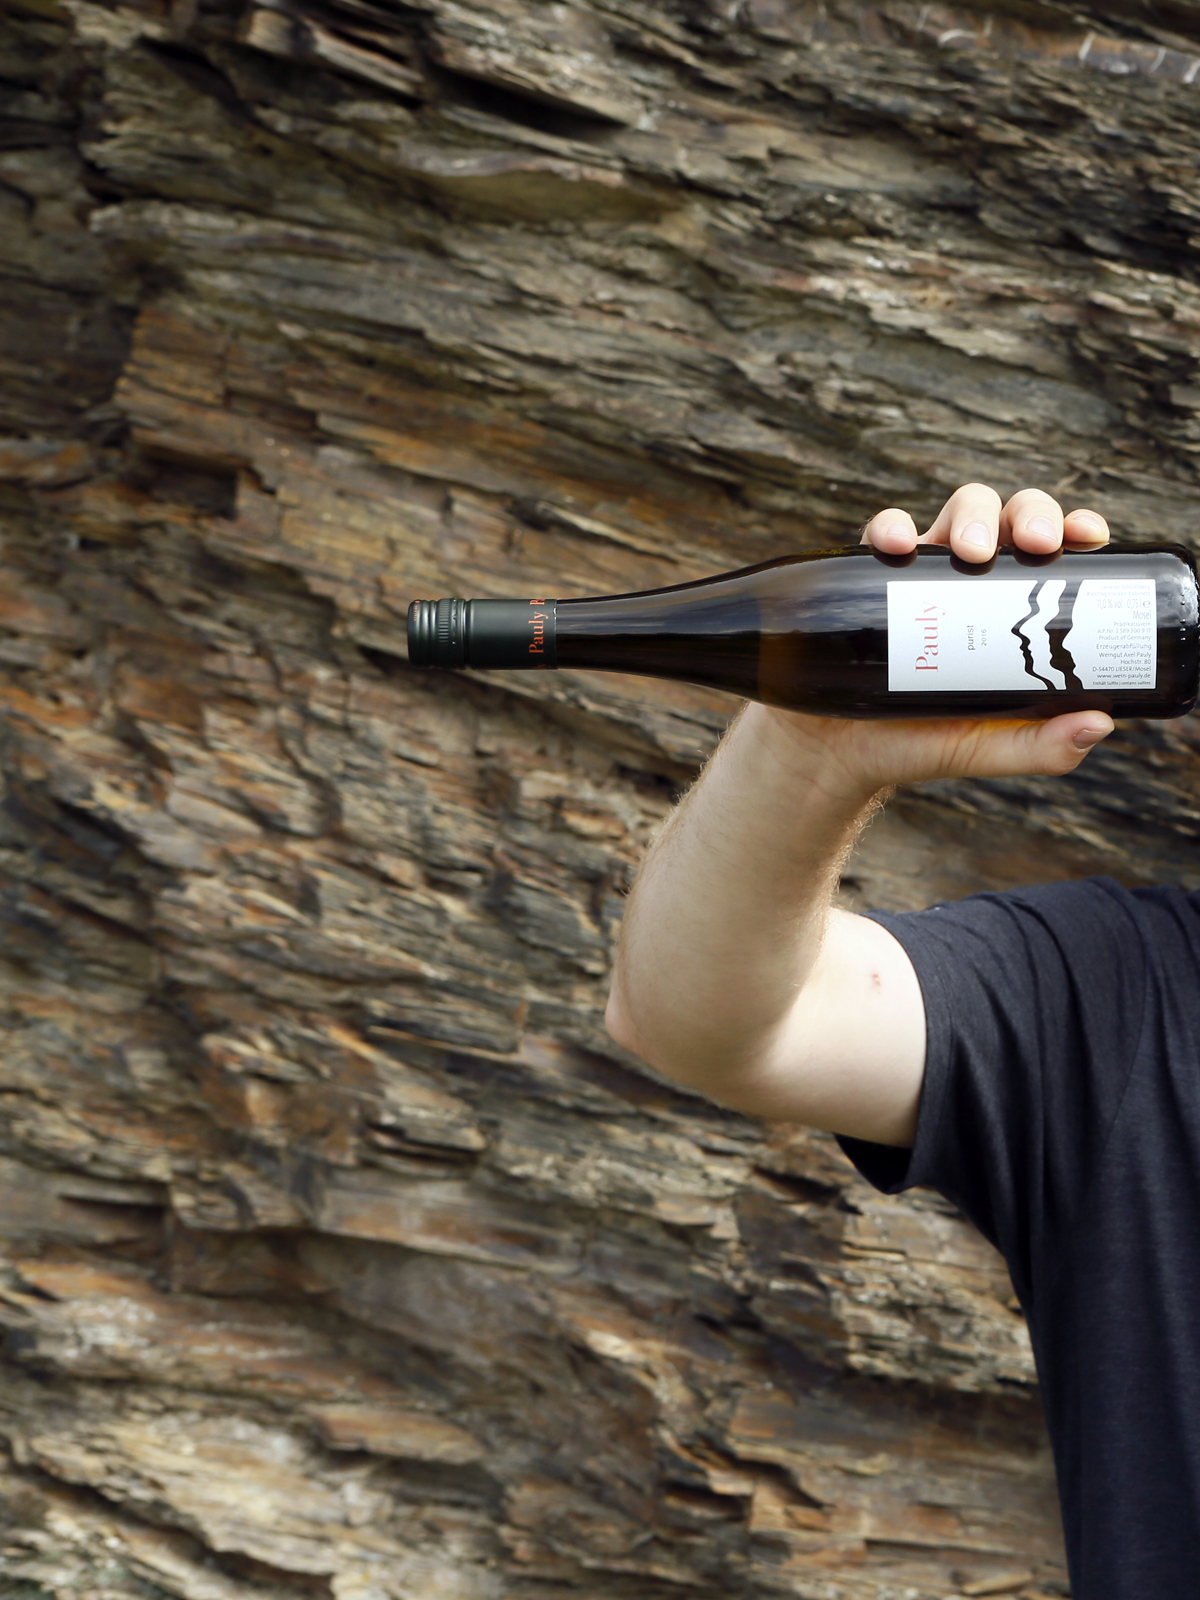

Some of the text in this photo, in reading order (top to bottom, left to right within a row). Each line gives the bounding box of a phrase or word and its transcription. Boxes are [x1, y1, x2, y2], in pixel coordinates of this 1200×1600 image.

[1132, 609, 1151, 620] Mosel
[528, 611, 549, 653] Pauly
[914, 601, 947, 673] Pauly
[967, 624, 976, 651] purist
[1098, 652, 1123, 660] Weingut
[1136, 651, 1152, 659] Pauly
